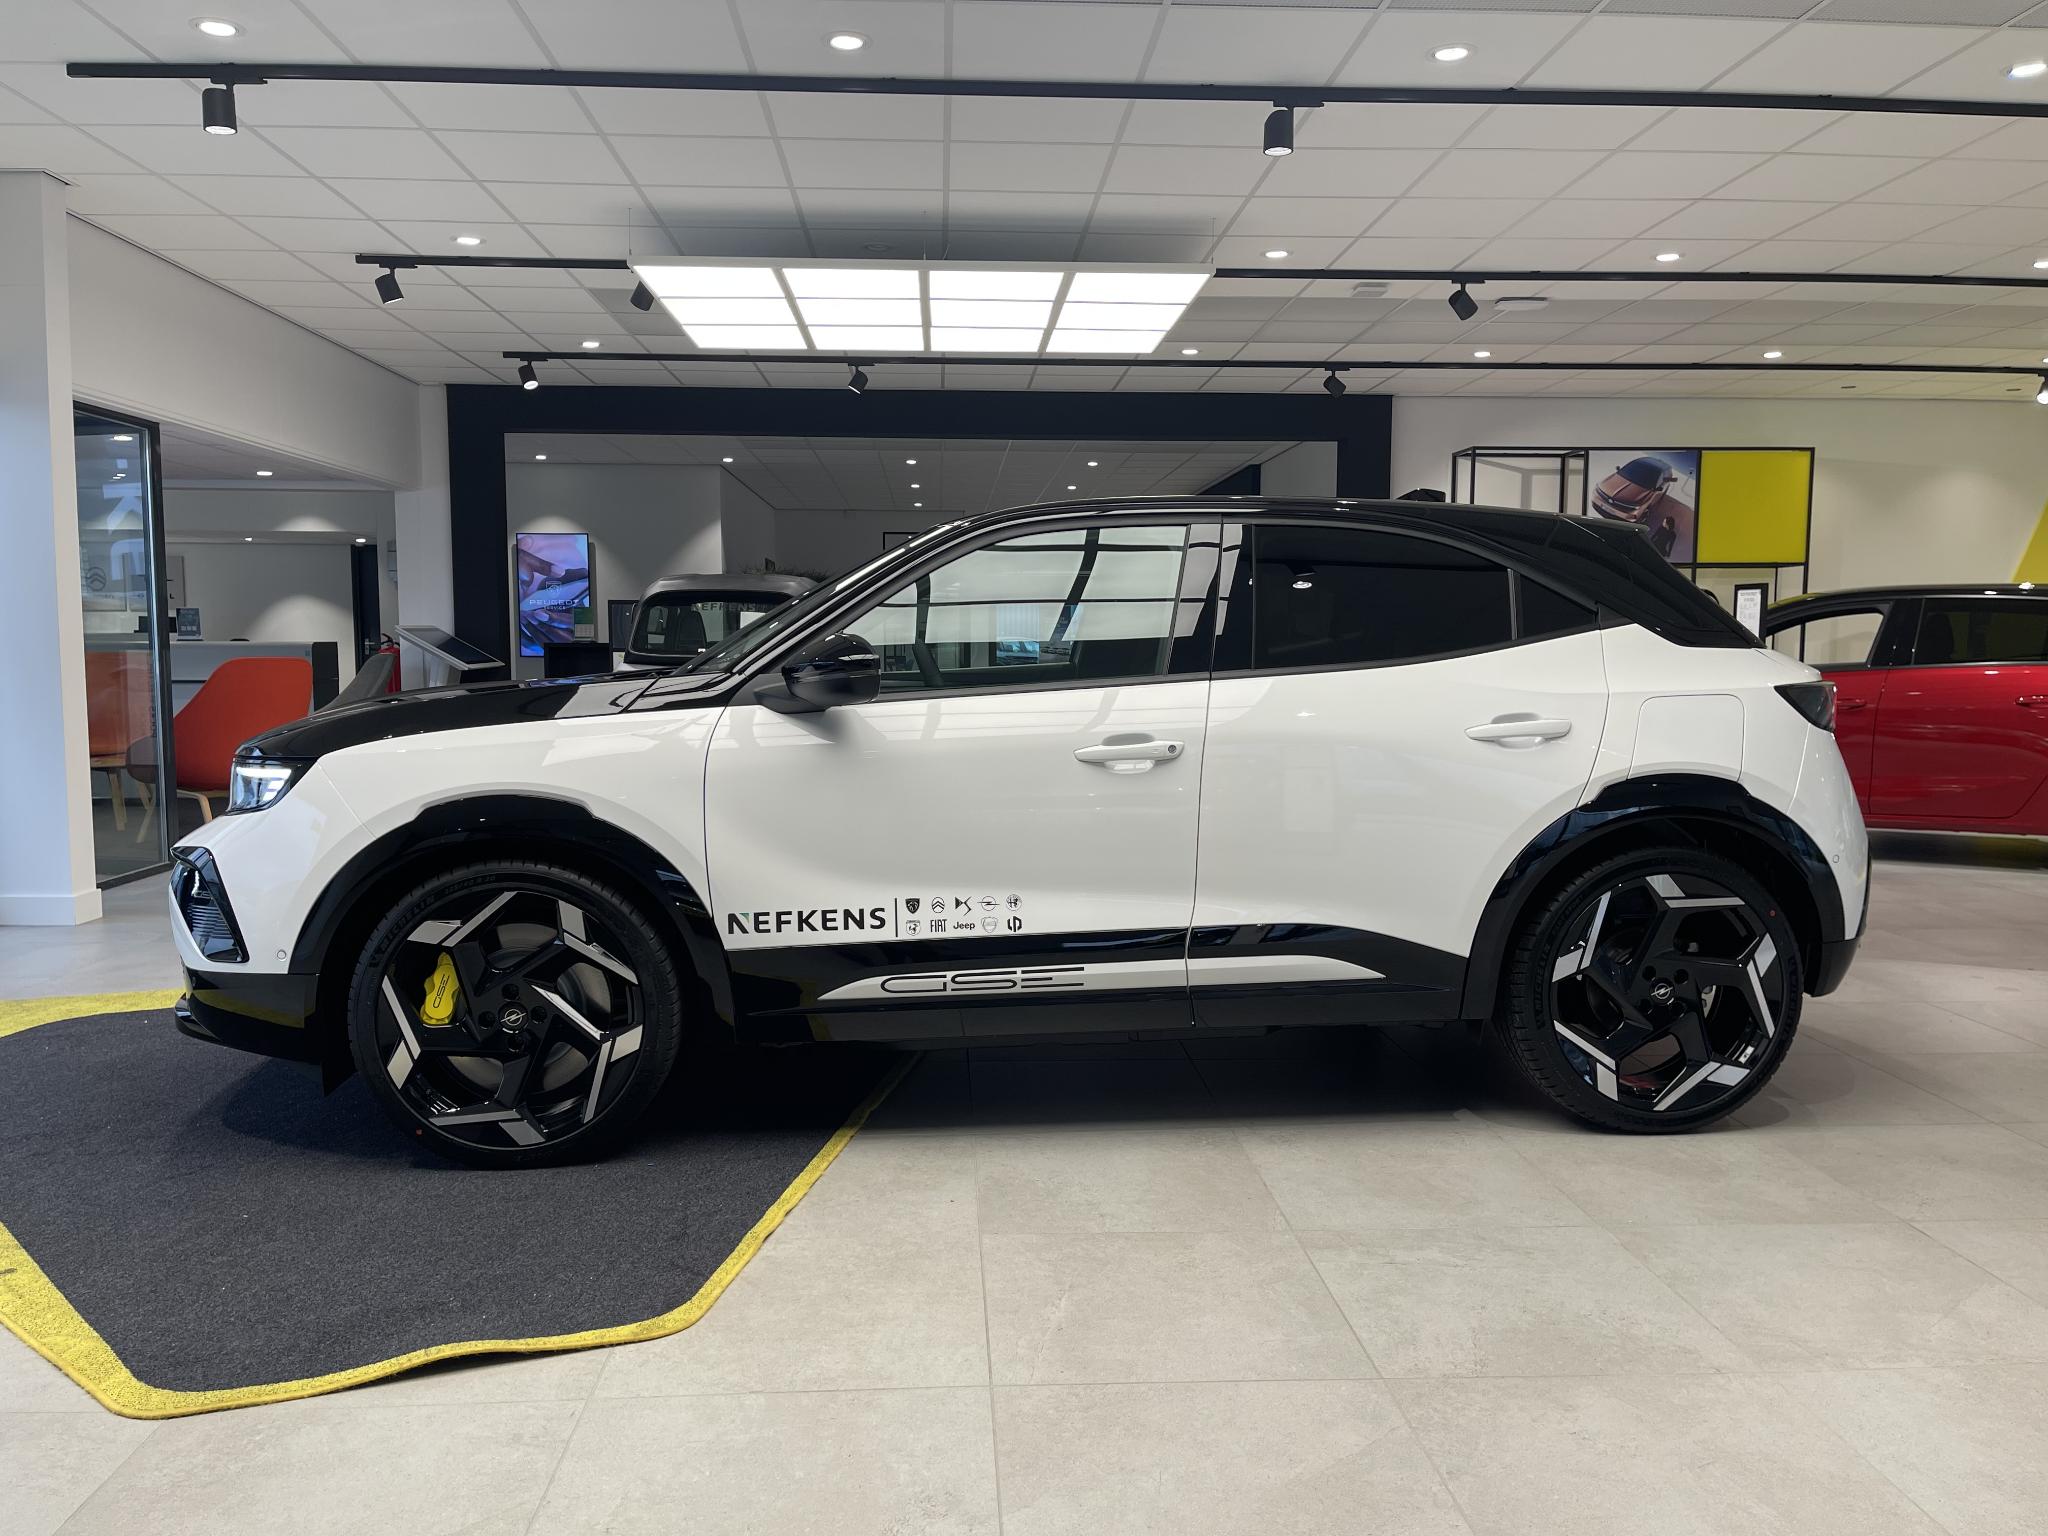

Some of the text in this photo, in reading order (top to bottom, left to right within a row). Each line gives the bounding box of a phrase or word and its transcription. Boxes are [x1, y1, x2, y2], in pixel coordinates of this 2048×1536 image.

[728, 907, 886, 935] NEFKENS
[930, 919, 948, 933] FIAT
[953, 921, 976, 931] Jeep
[433, 974, 450, 1008] GSE
[880, 966, 1085, 994] GSE
